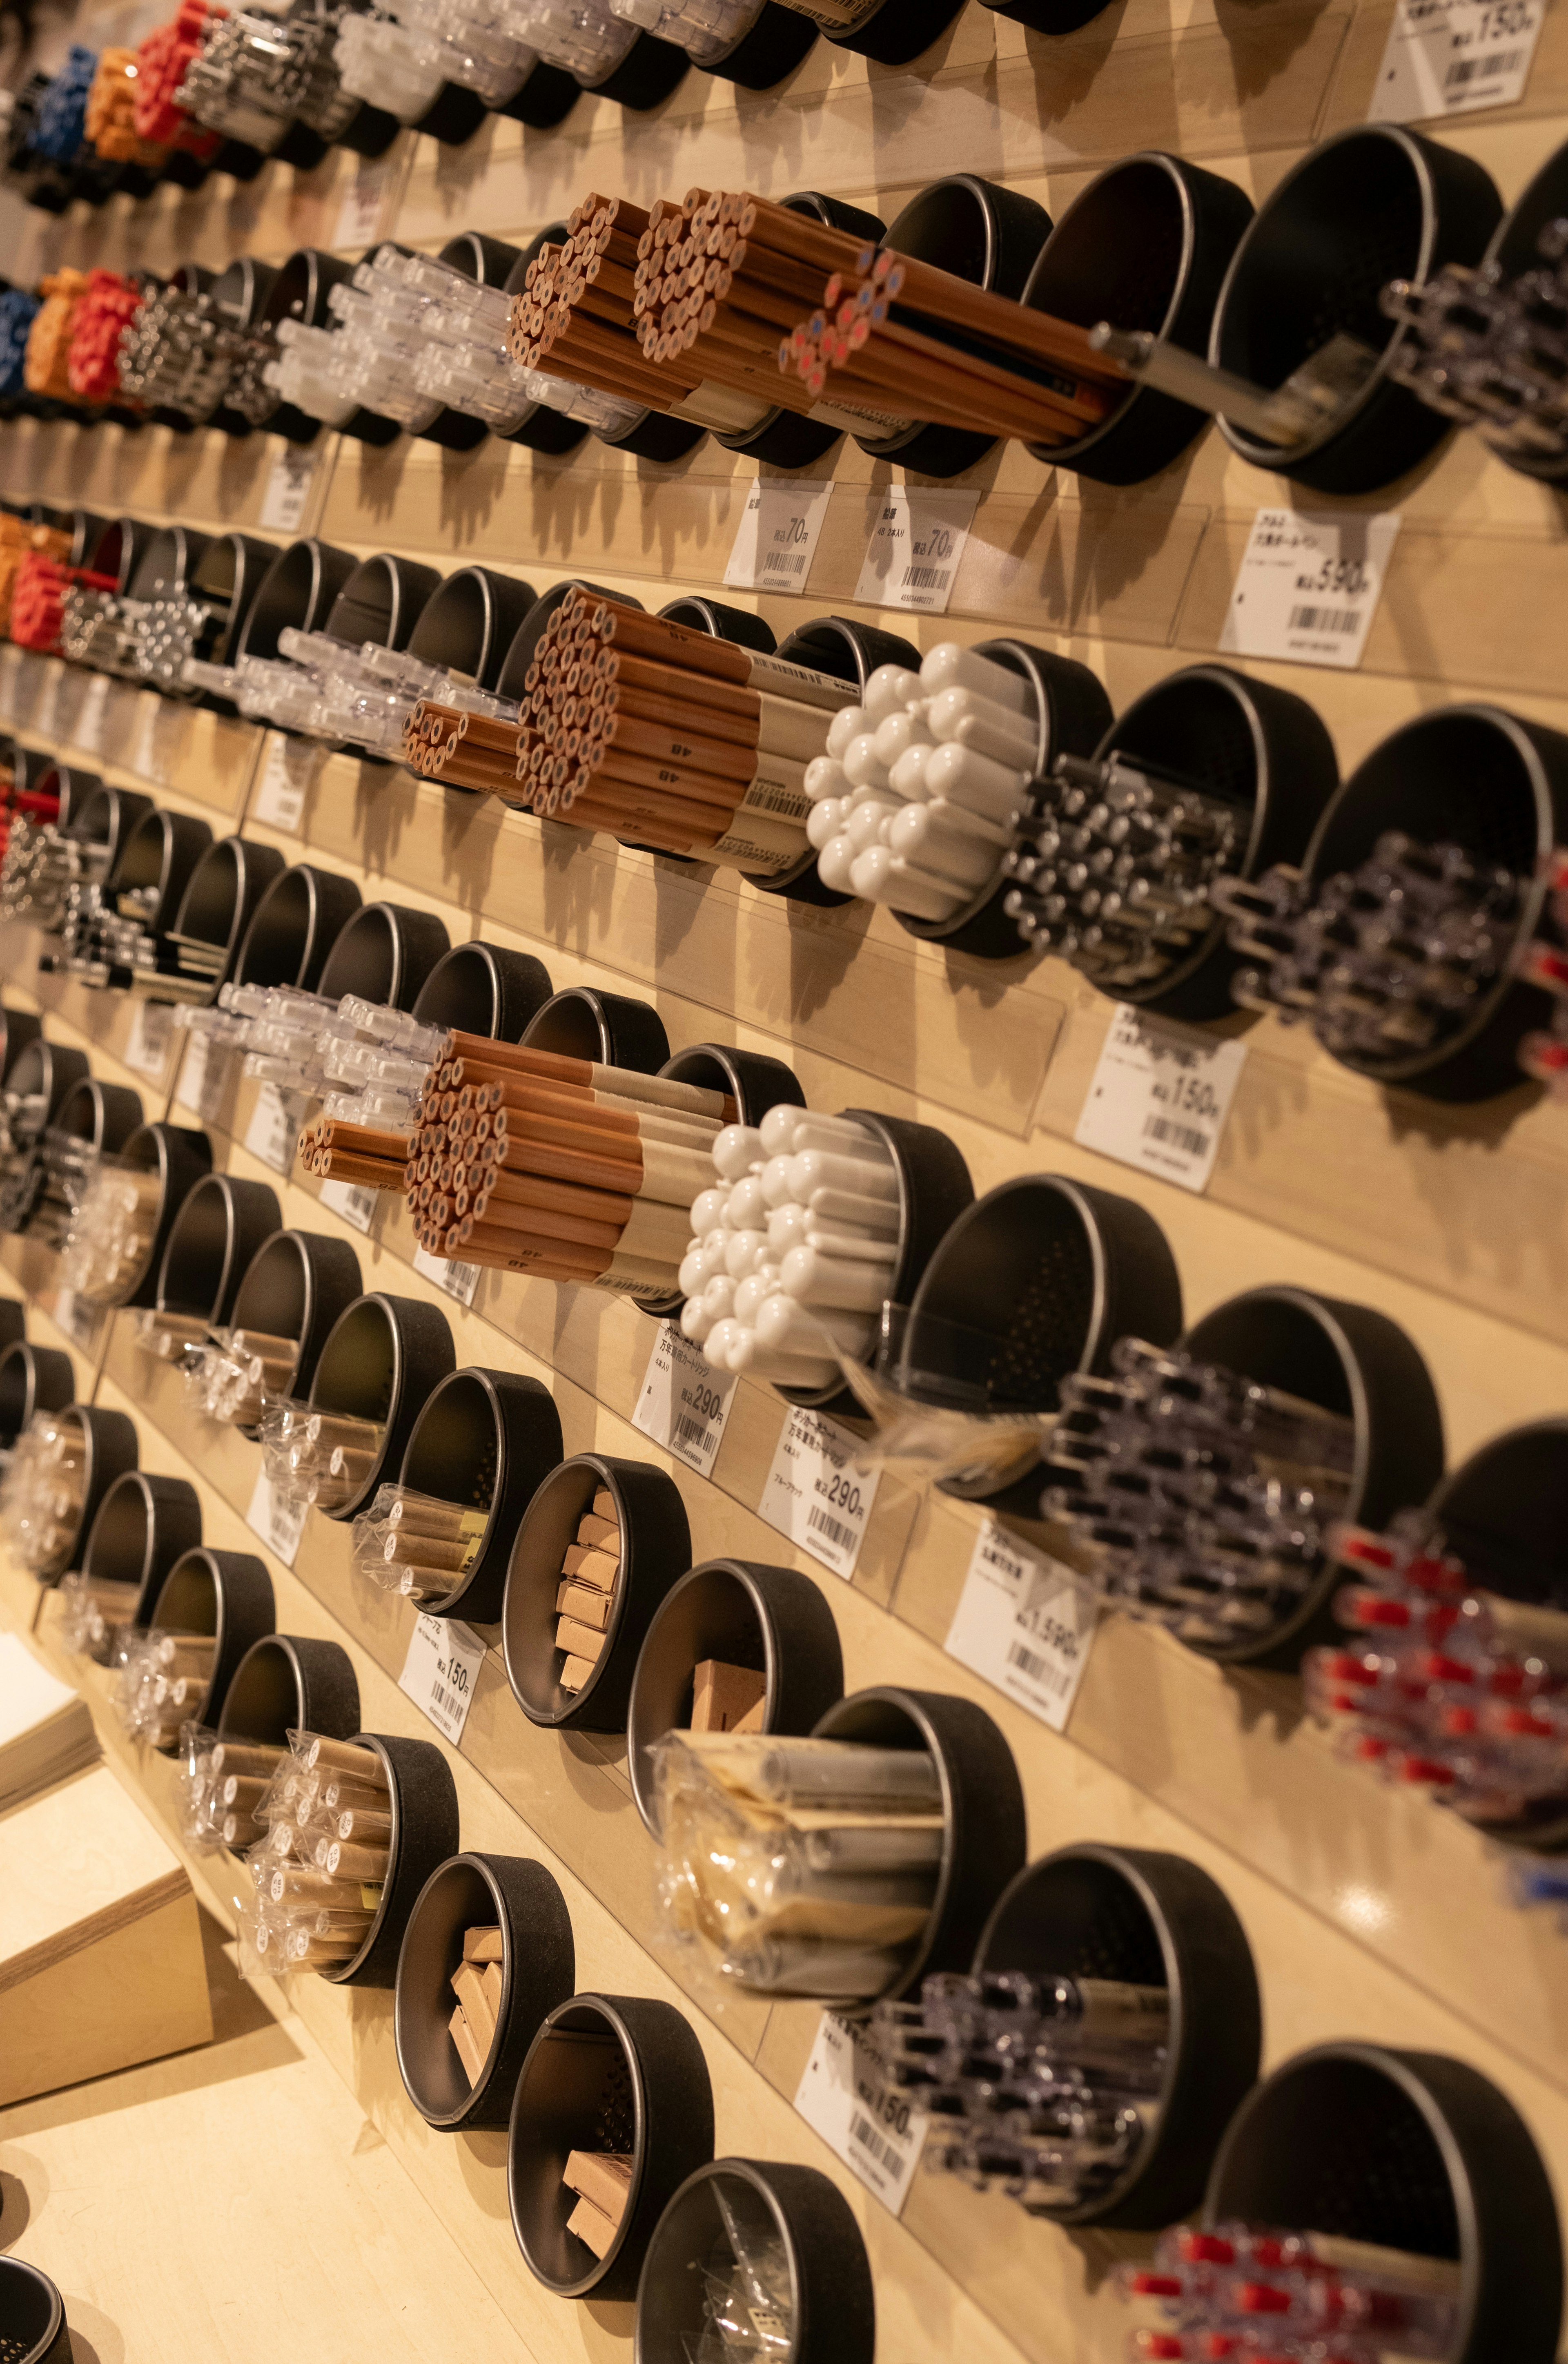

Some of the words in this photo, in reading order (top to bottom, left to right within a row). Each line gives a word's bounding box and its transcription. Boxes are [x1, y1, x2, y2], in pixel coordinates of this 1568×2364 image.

[748, 498, 761, 510] 鉛筆
[882, 507, 897, 520] 鉛筆
[877, 527, 885, 536] 4B
[887, 528, 904, 537] 2本入り
[672, 744, 692, 757] 4B
[659, 770, 679, 783] 4B
[659, 1338, 710, 1377] 万年筆用カートリッジ
[655, 1357, 670, 1372] 4本入り
[681, 1383, 724, 1425] 税込290円
